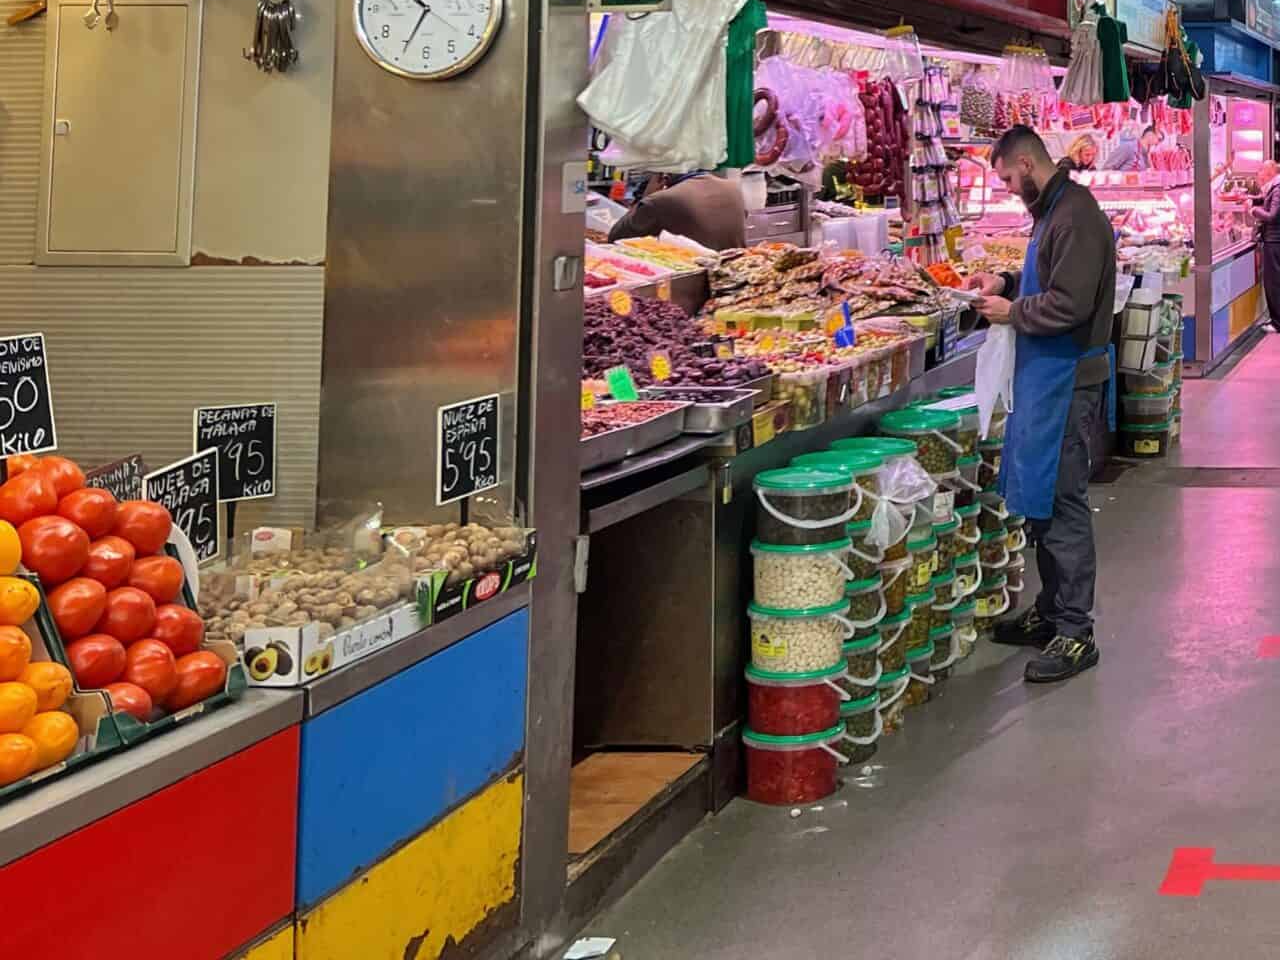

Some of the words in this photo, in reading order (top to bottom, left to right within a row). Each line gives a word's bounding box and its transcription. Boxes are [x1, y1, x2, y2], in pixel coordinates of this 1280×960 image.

[381, 24, 391, 39] 8
[467, 24, 475, 37] 4
[421, 46, 430, 60] 6
[447, 39, 456, 54] 5
[22, 337, 41, 352] DE
[443, 404, 475, 430] NUEZ
[477, 399, 494, 415] DE
[148, 468, 185, 500] NUEZ
[191, 457, 211, 478] DE
